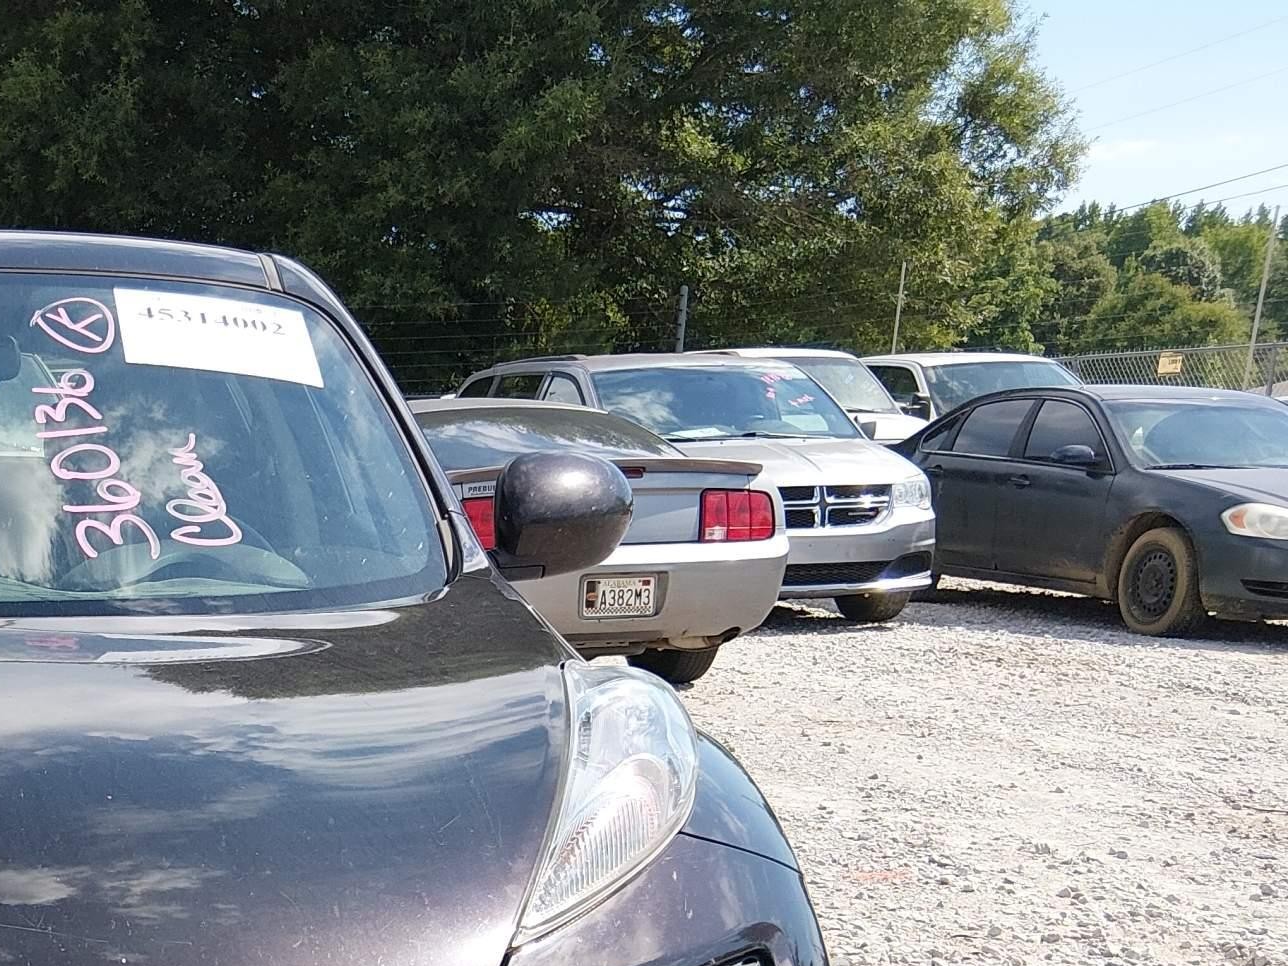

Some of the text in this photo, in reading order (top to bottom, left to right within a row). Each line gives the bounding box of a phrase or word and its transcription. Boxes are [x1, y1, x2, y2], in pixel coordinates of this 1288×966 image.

[138, 306, 286, 336] 45314002
[32, 367, 161, 560] 360136
[166, 432, 243, 546] Clean
[600, 588, 651, 608] A382M3
